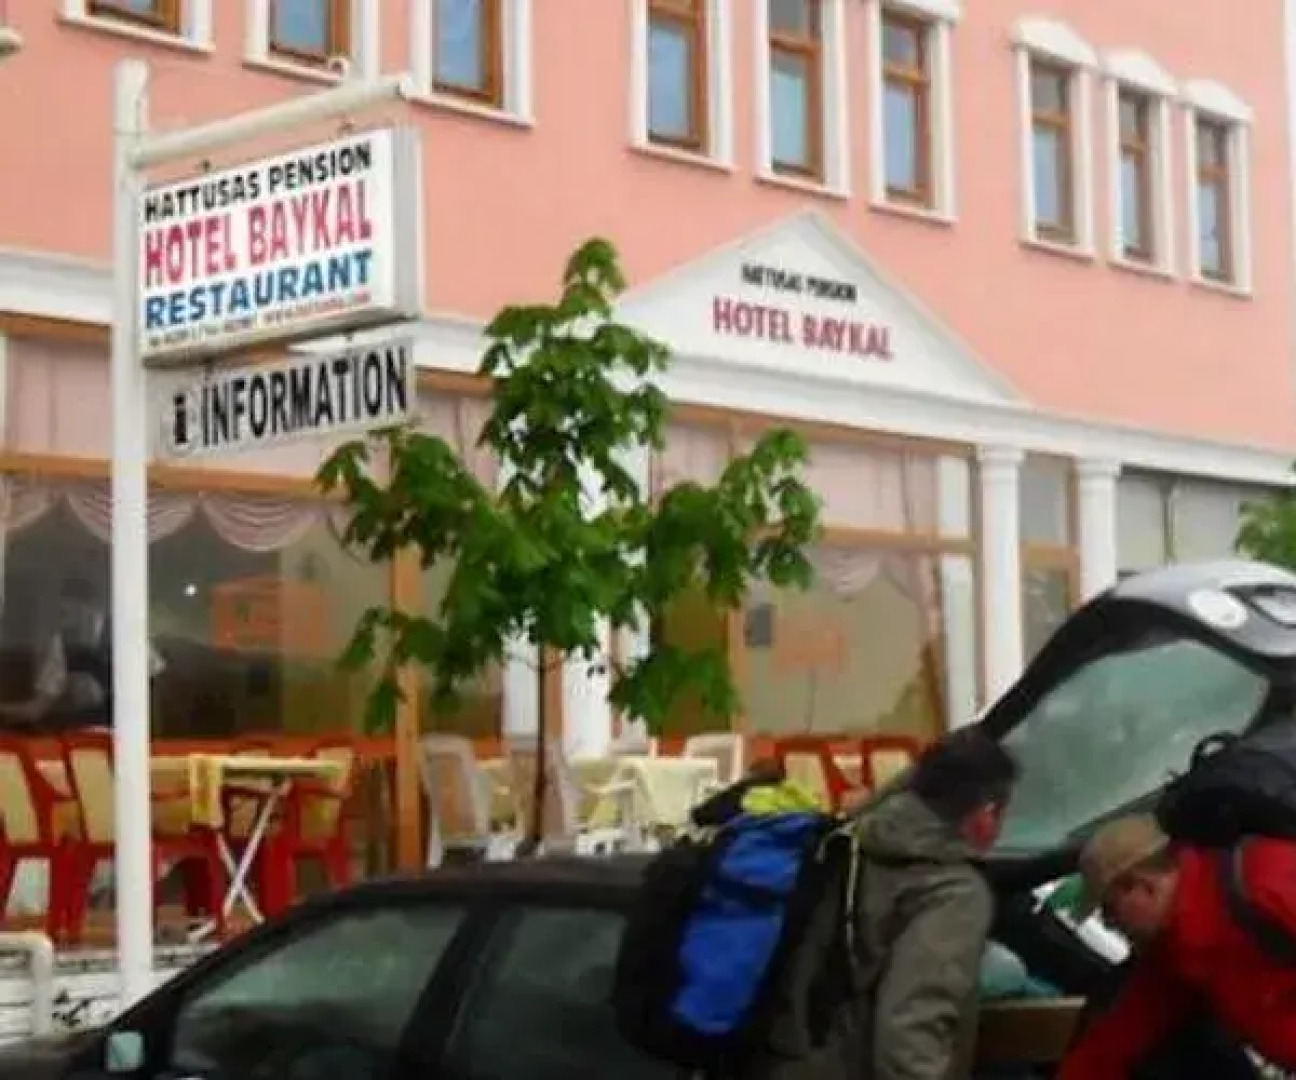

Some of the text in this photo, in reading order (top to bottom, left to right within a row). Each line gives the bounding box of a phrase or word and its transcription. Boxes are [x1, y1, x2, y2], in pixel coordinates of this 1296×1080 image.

[144, 142, 372, 223] HATTUSAS PENSION
[144, 179, 373, 287] HOTEL BAYKAL
[144, 250, 373, 329] RESTAURANT
[713, 295, 895, 362] HOTEL BAYKAL
[201, 345, 407, 447] INFORMATION
